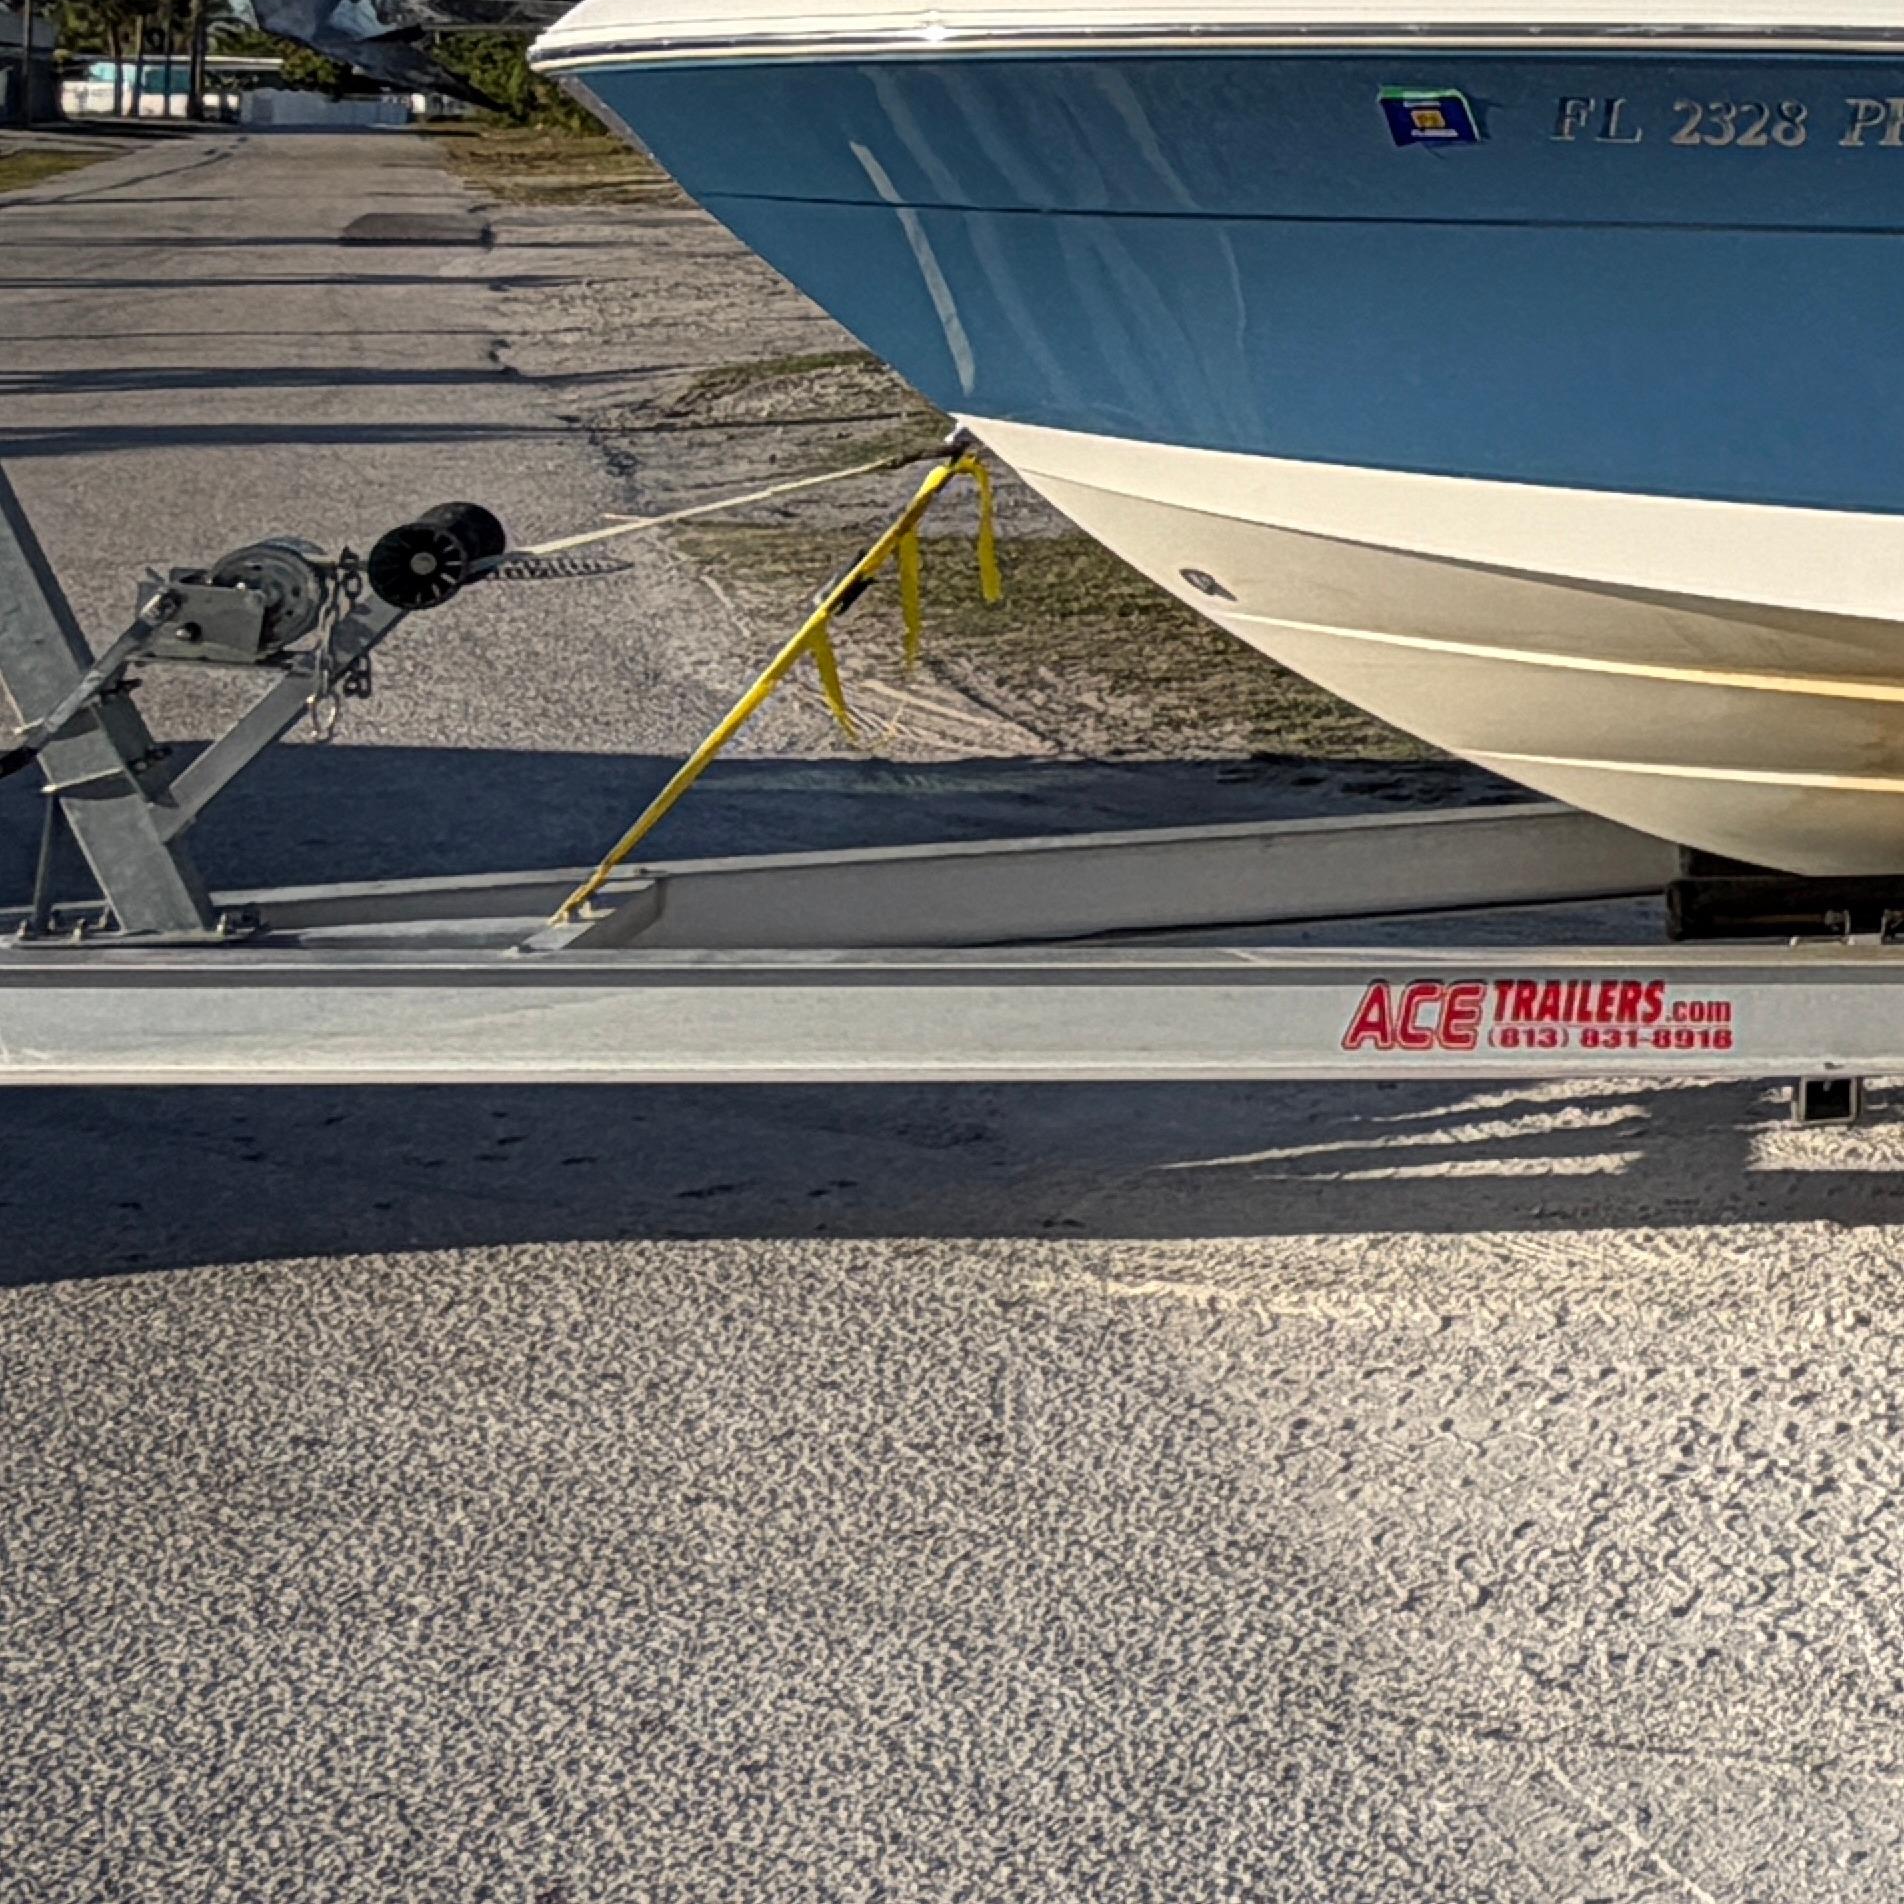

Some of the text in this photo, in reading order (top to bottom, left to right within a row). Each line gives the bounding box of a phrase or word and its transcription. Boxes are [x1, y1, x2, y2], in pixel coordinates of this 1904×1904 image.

[1550, 95, 1643, 144] FL
[1670, 100, 1809, 147] 2328
[1340, 977, 1732, 1051] ACE TRAILERS.com
[1487, 1027, 1570, 1050] (813)
